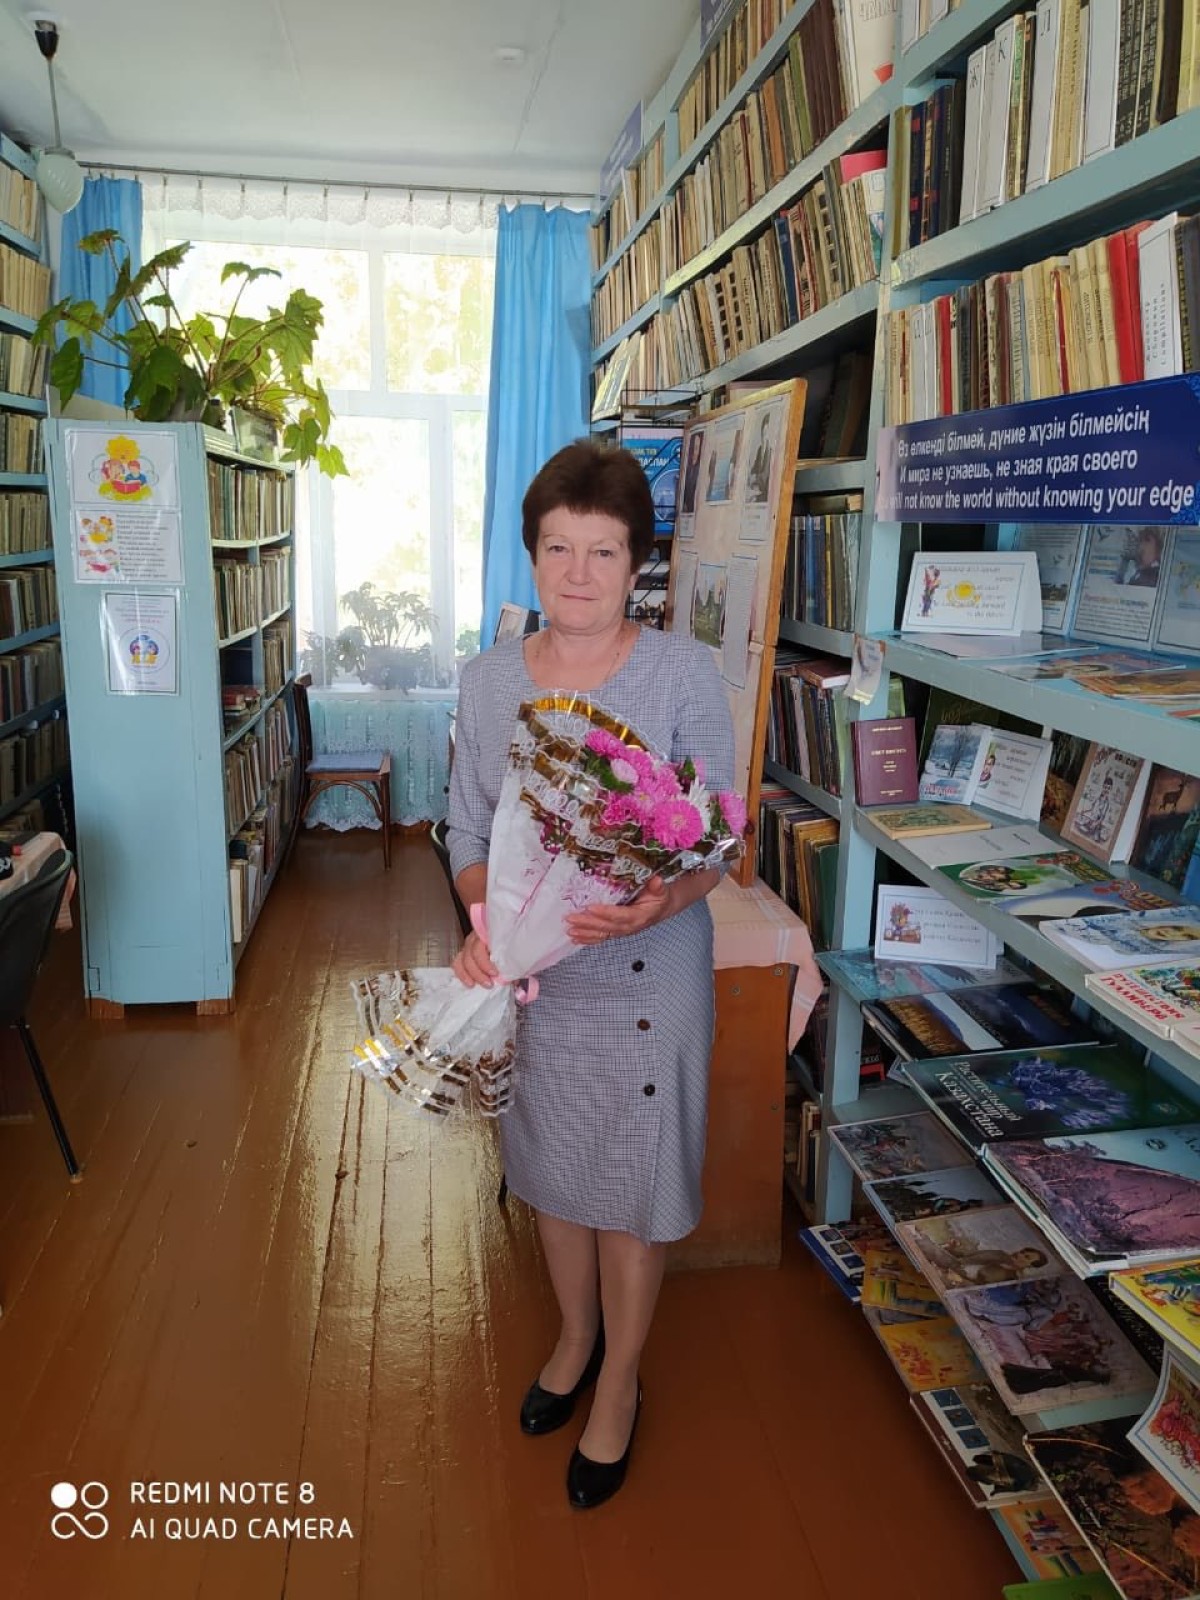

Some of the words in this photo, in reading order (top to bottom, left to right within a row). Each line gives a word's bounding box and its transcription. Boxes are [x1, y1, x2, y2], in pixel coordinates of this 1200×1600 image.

[1069, 405, 1150, 438] білмейсің
[908, 467, 929, 486] мира
[931, 466, 943, 481] не
[945, 462, 992, 485] узнаешь,
[995, 460, 1011, 477] не
[1013, 457, 1043, 477] зная
[1046, 454, 1079, 479] края
[1083, 450, 1138, 472] своего
[904, 493, 918, 509] not
[920, 491, 942, 509] know
[945, 489, 960, 508] the
[963, 487, 993, 509] world
[996, 485, 1040, 508] without
[1043, 481, 1103, 513] knowing
[1106, 485, 1146, 513] your
[1149, 479, 1195, 513] edge
[935, 1071, 1004, 1137] Казахстана
